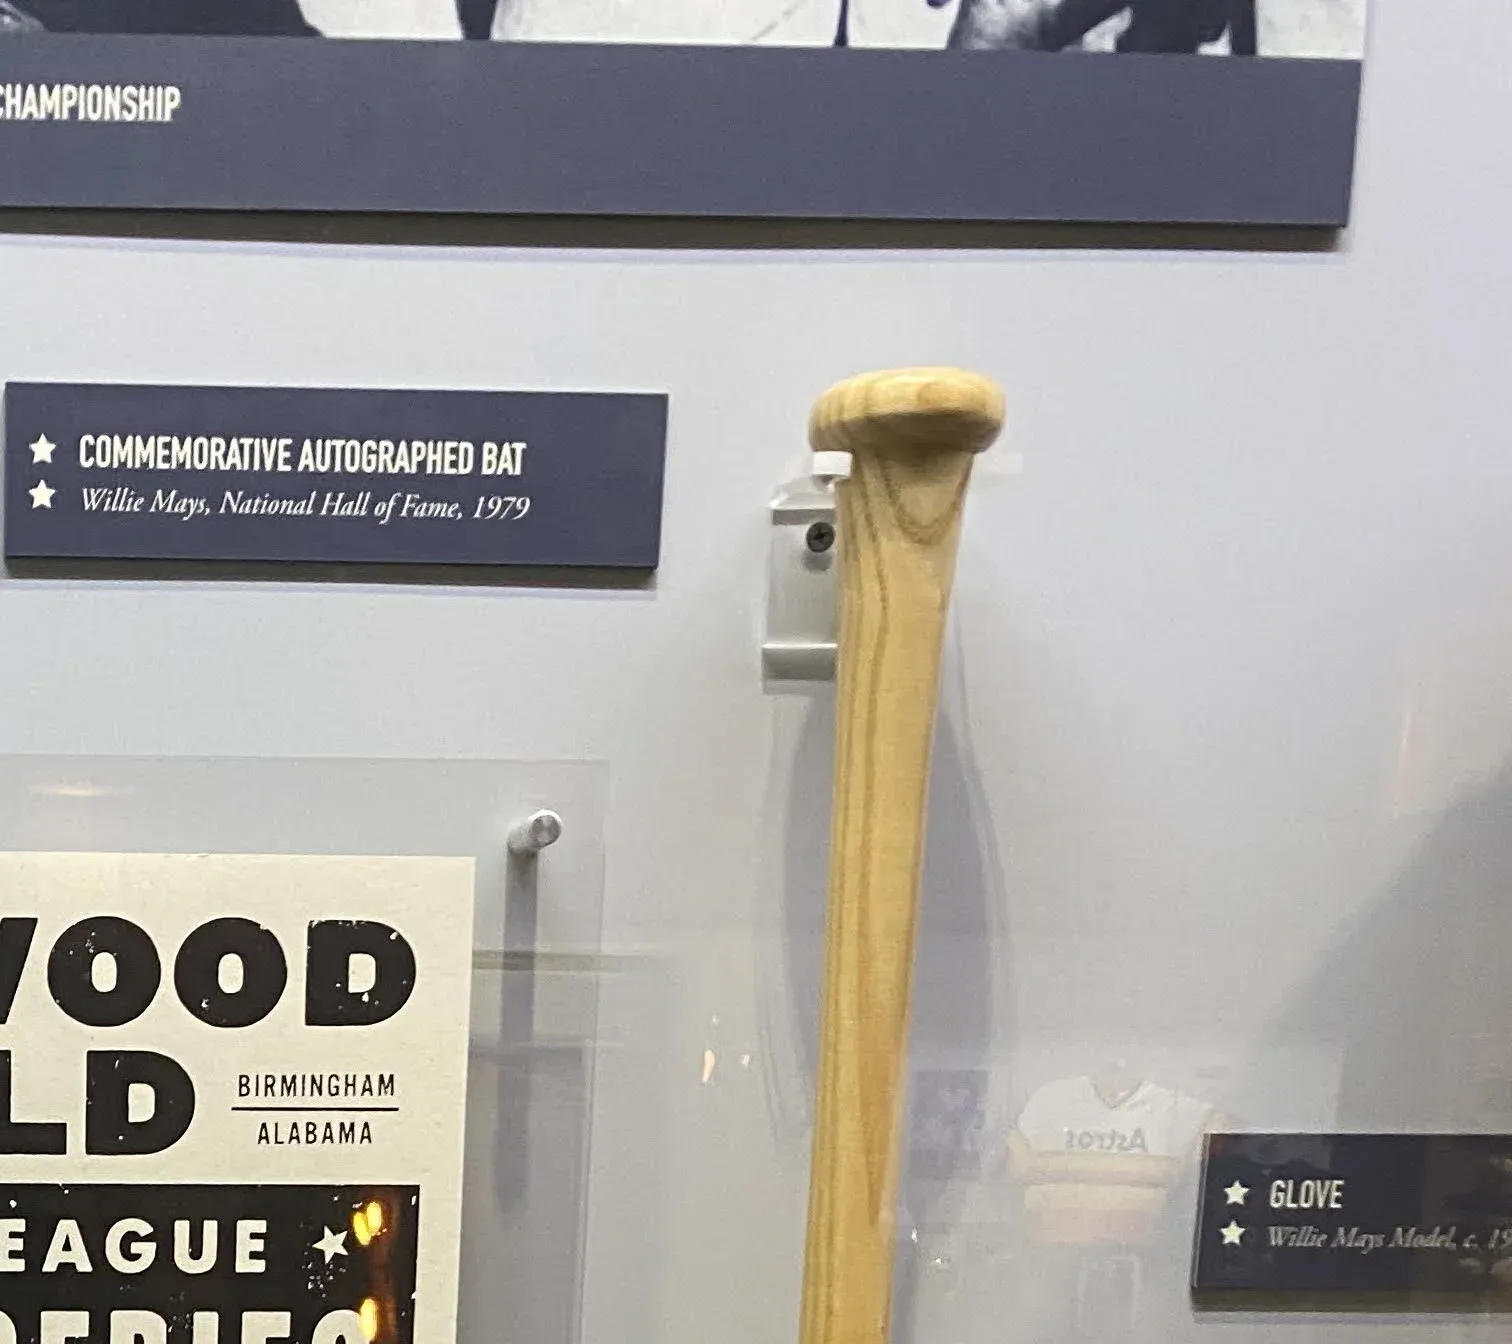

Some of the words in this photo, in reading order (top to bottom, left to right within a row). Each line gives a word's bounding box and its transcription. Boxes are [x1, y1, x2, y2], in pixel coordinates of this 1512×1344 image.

[79, 435, 291, 471] COMMEMORATIVE
[297, 439, 473, 474] AUTOGRAPHED
[481, 442, 526, 476] BAT
[82, 488, 143, 514] Willie
[151, 492, 210, 518] Mays,
[219, 491, 315, 516] National
[320, 493, 369, 517] Hall
[374, 493, 402, 525] of
[400, 494, 464, 520] Fame,
[472, 496, 530, 520] 1979
[237, 1072, 397, 1099] BIRMINGHAM
[256, 1120, 373, 1146] ALABAMA
[1269, 1180, 1343, 1209] GLOVE
[1268, 1225, 1328, 1248] Willie
[1332, 1227, 1384, 1253] Mays
